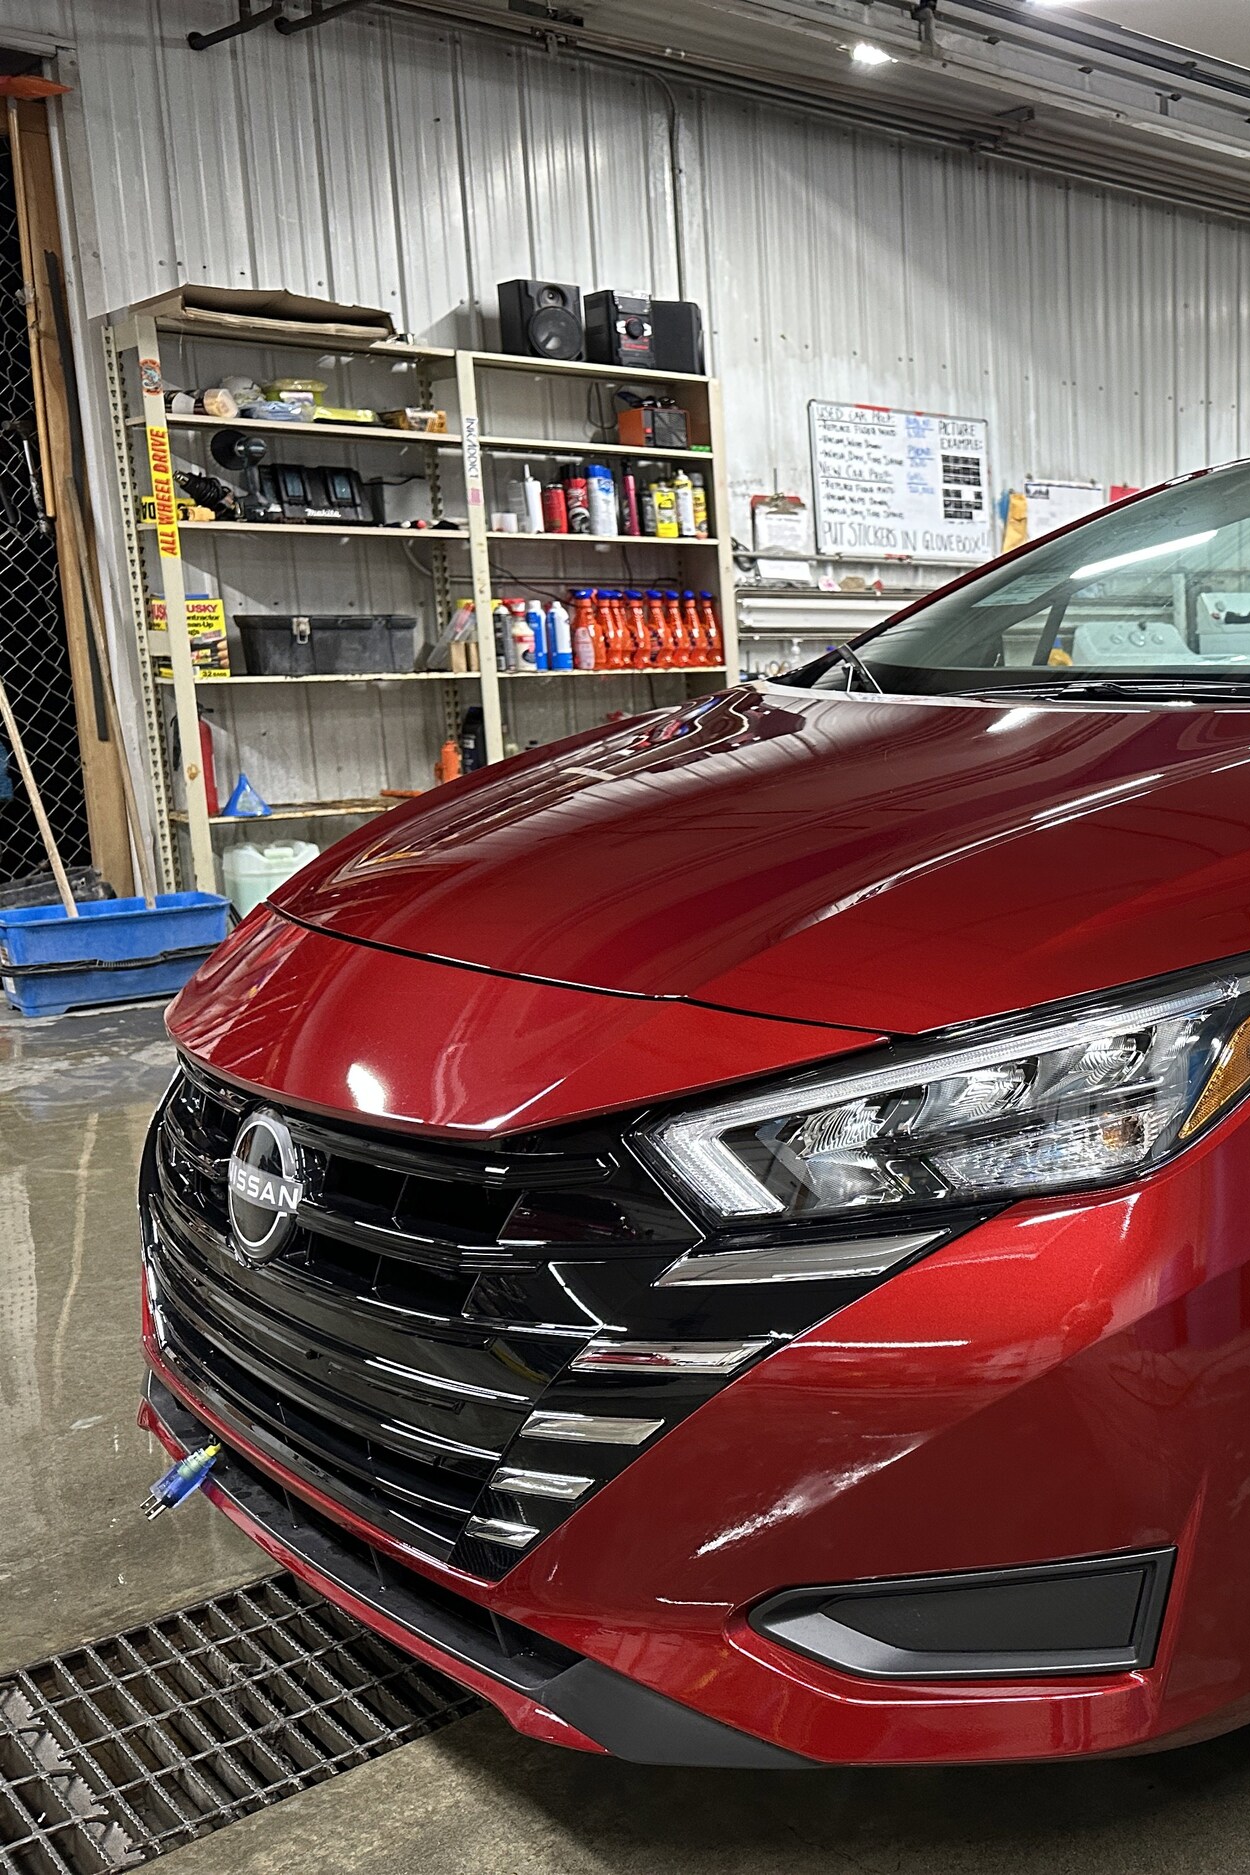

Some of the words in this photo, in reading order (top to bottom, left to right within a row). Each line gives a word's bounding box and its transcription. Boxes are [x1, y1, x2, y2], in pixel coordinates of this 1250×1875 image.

[817, 407, 844, 421] USED
[848, 410, 867, 422] CAR
[939, 420, 976, 436] PICTURE
[150, 429, 169, 473] DRIVE
[819, 461, 841, 477] NEW
[846, 465, 863, 478] CAR
[155, 478, 175, 525] WHEEL
[305, 508, 341, 518] Makita
[159, 530, 178, 556] ALL
[822, 521, 844, 546] PUT
[847, 522, 896, 547] STICKERS
[901, 530, 917, 552] IN
[186, 604, 218, 614] USKY
[228, 1161, 299, 1210] NISSAN
